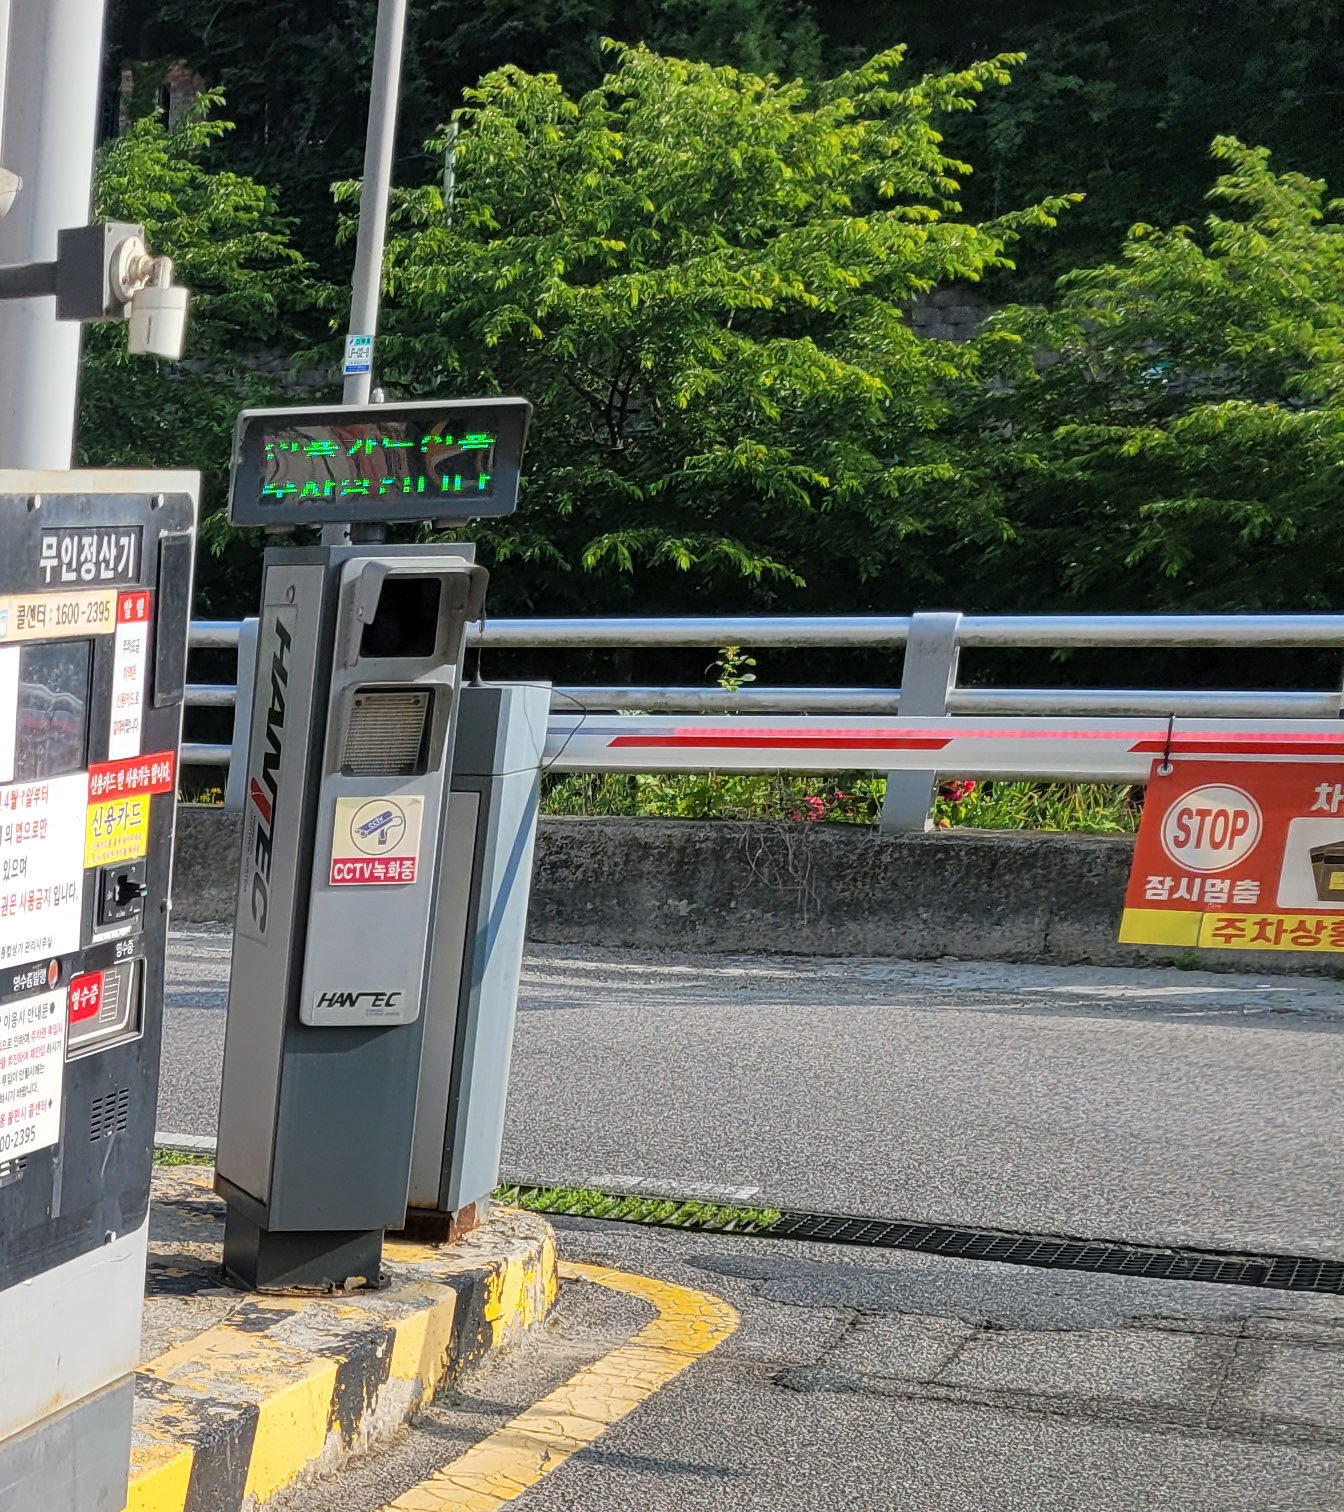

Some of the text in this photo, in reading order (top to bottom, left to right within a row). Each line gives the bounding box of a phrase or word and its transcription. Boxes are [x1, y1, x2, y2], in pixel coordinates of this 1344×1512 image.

[39, 533, 135, 583] 무인정산기
[250, 617, 291, 934] HANTEC
[93, 802, 142, 837] 신용카드
[1173, 808, 1249, 850] STOP
[334, 861, 415, 880] CCTV녹화중
[19, 885, 51, 912] 사용금지
[1145, 876, 1260, 904] 잠시멈춤
[72, 984, 98, 1010] 영수증
[4, 1009, 25, 1030] 이용시
[28, 1003, 48, 1023] 안내문
